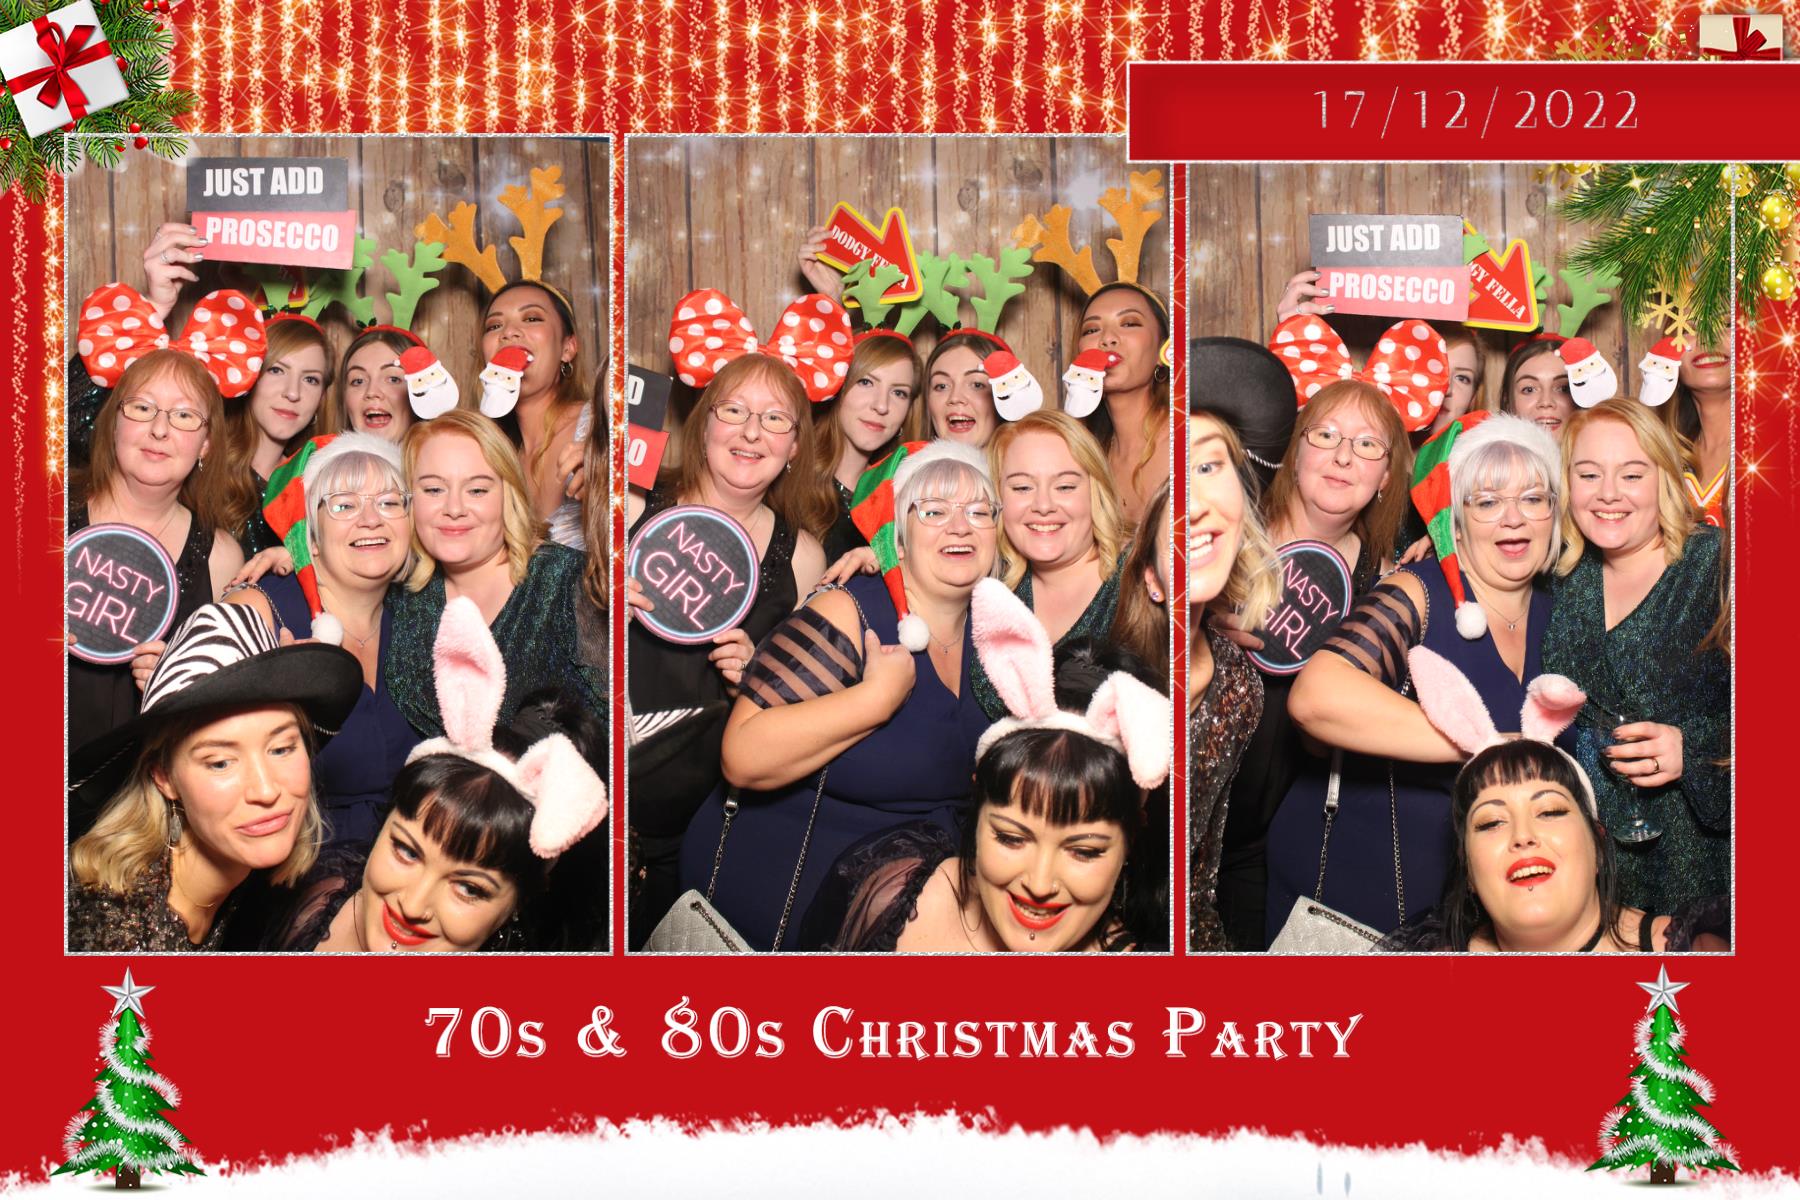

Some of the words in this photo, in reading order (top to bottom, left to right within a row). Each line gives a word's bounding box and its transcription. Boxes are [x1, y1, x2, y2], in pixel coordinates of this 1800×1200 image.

[203, 167, 265, 197] JUST
[270, 166, 324, 196] ADD
[205, 216, 340, 252] PROSECCO
[831, 224, 871, 260] DODGY
[1326, 224, 1384, 253] JUST
[1390, 223, 1441, 251] ADD
[1329, 271, 1455, 305] PROSECCO
[1485, 277, 1526, 319] FELLA
[75, 546, 165, 603] NASTY
[667, 521, 745, 595] NASTY
[643, 550, 712, 631] GIRL
[1279, 558, 1340, 624] NASTY
[68, 581, 139, 644] GIRL
